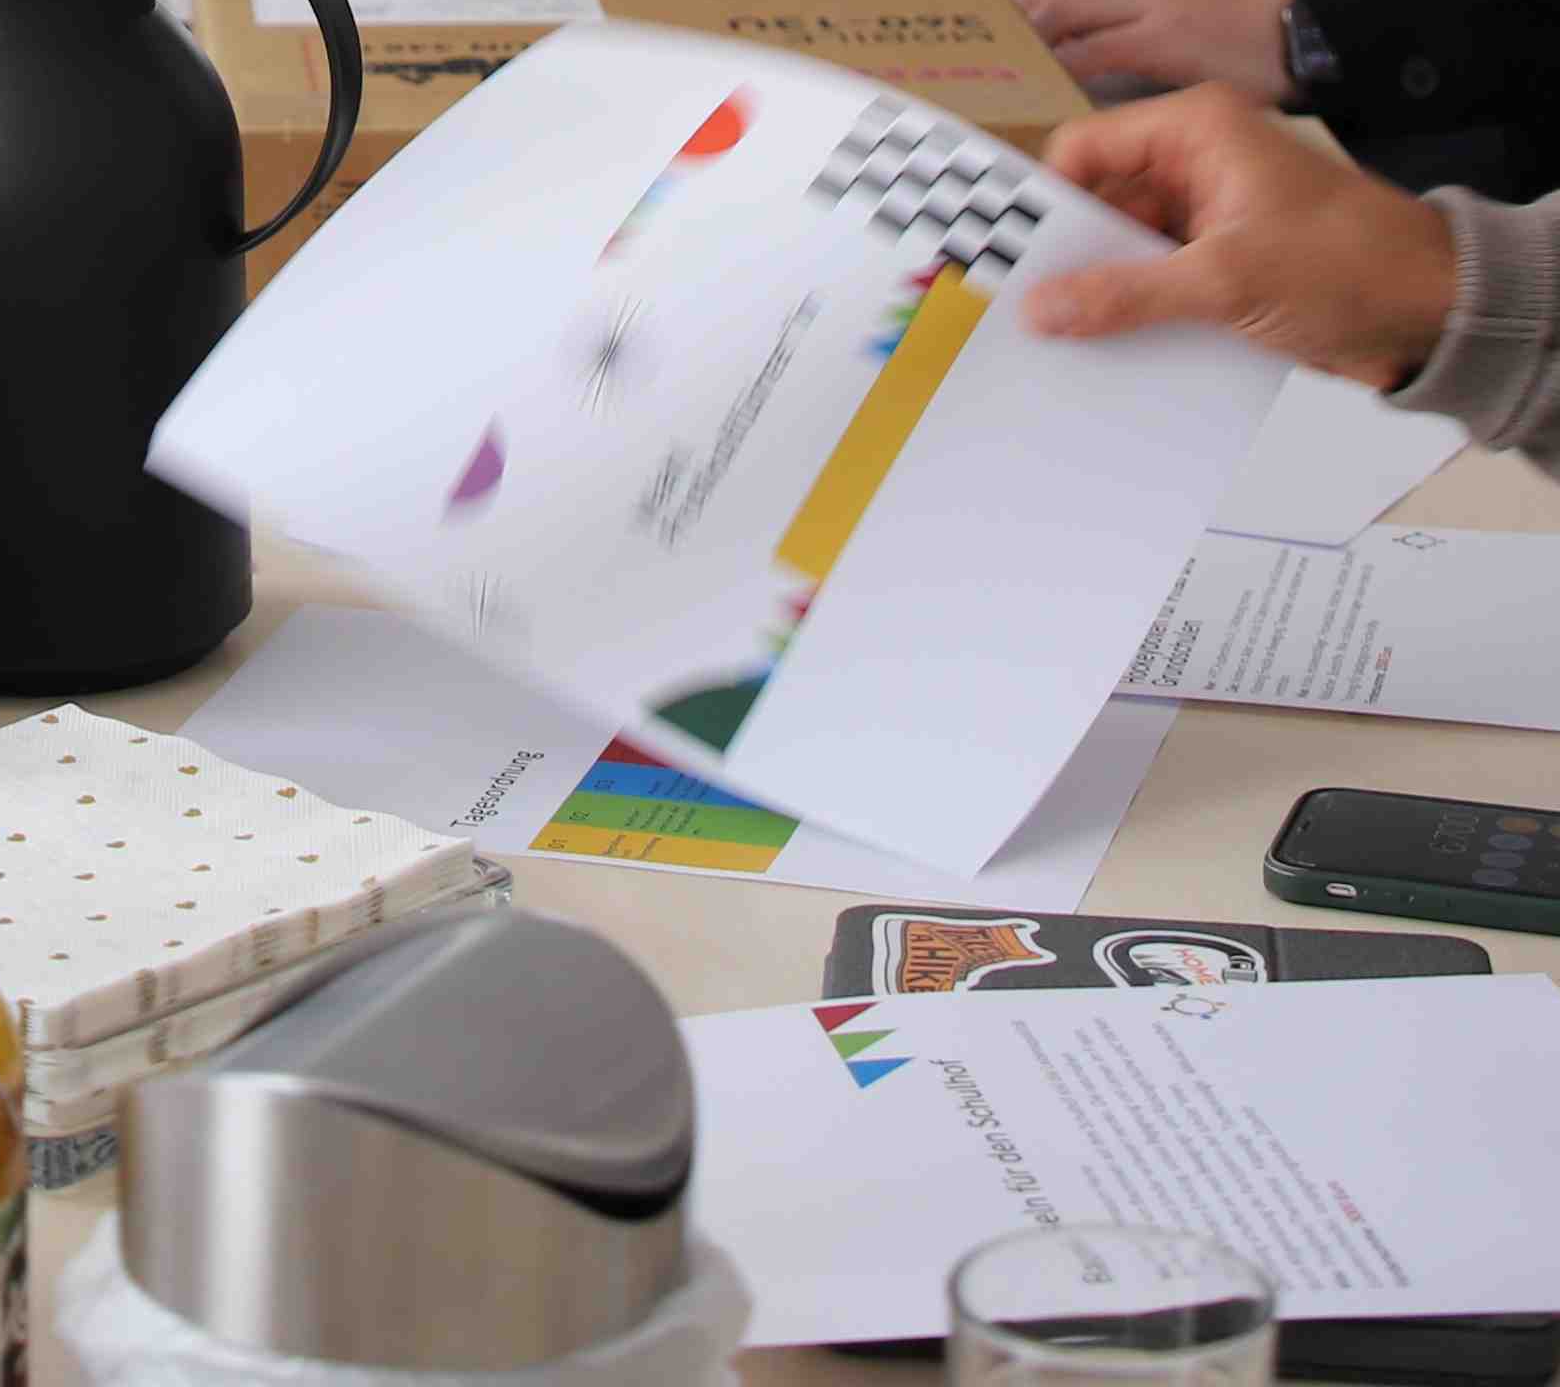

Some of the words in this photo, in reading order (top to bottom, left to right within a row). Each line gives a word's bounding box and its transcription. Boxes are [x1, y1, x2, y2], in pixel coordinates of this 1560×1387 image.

[448, 749, 548, 831] Tagesordnung
[924, 1058, 1005, 1128] Schulhof
[979, 1130, 1026, 1160] den
